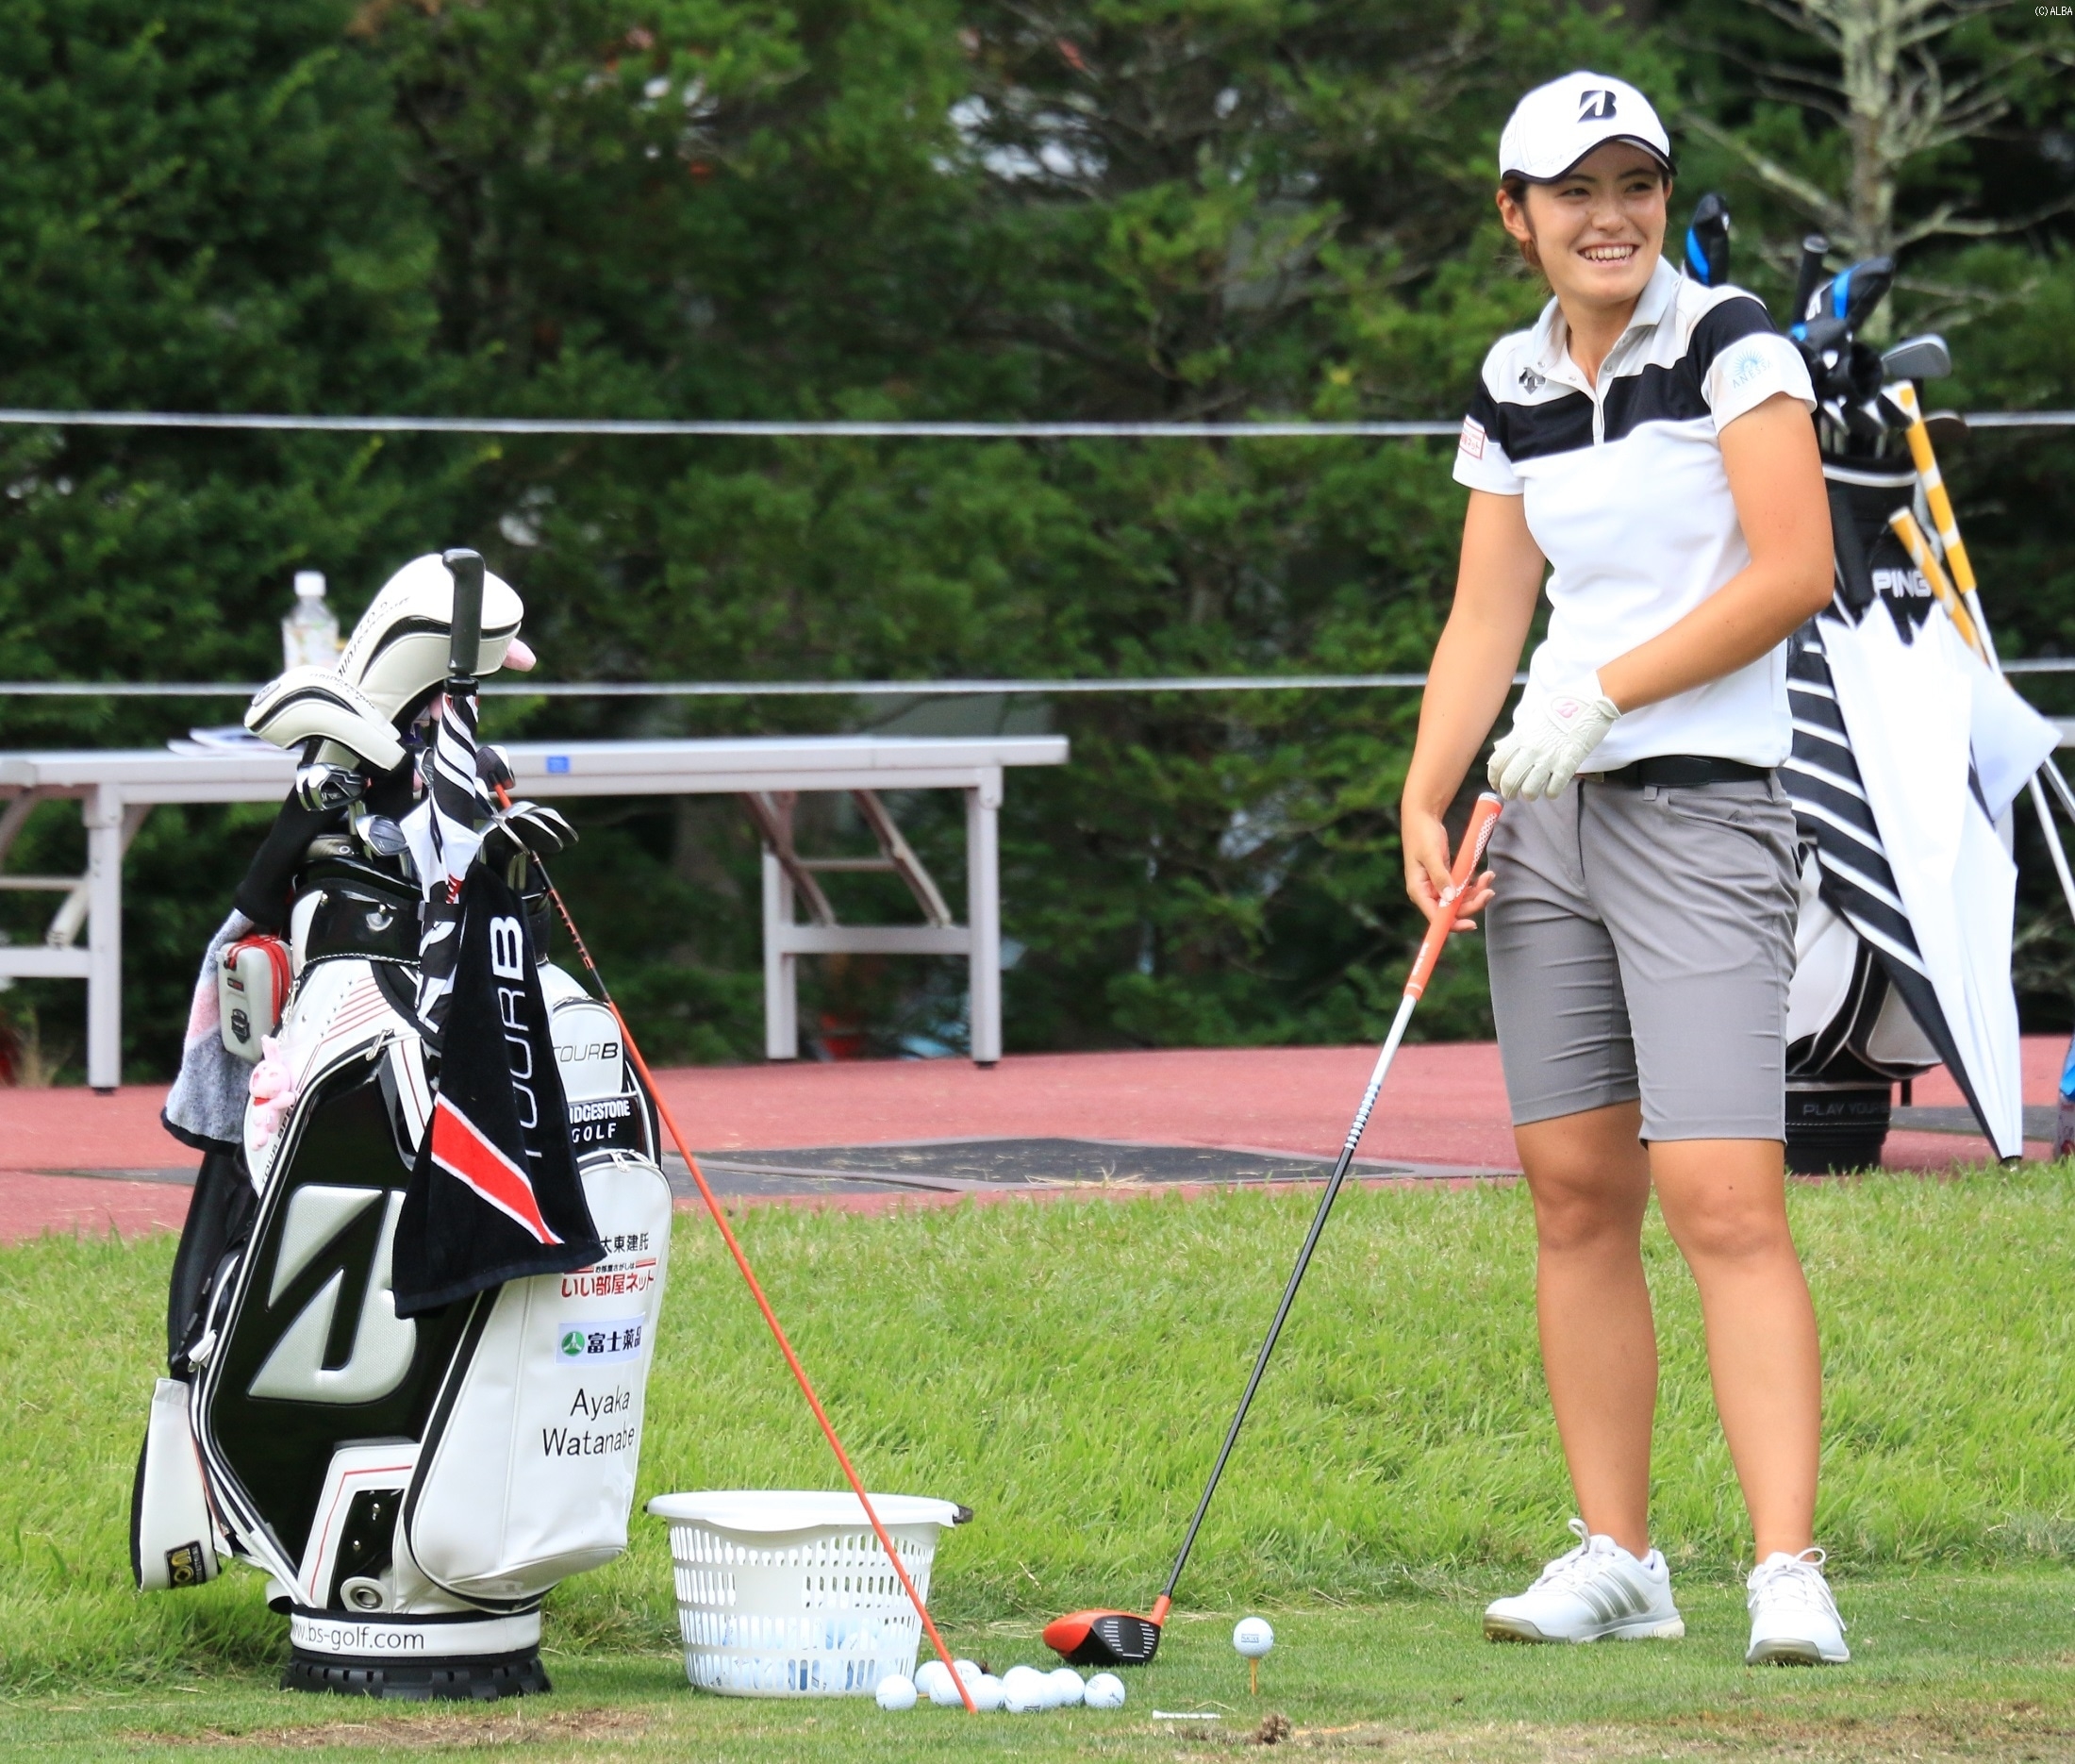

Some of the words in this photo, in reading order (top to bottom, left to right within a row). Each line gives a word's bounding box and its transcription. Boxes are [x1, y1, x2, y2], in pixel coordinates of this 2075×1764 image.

[1871, 569, 1933, 598] PING
[569, 1100, 631, 1124] IDGESTONE
[1802, 1103, 1845, 1116] PLAY
[572, 1123, 617, 1143] GOLF
[600, 1232, 649, 1254] 大東建託
[561, 1270, 655, 1298] いい部屋ネット
[587, 1325, 642, 1354] 富士薬品
[570, 1385, 631, 1422] Ayaka
[542, 1421, 635, 1456] Watanabe
